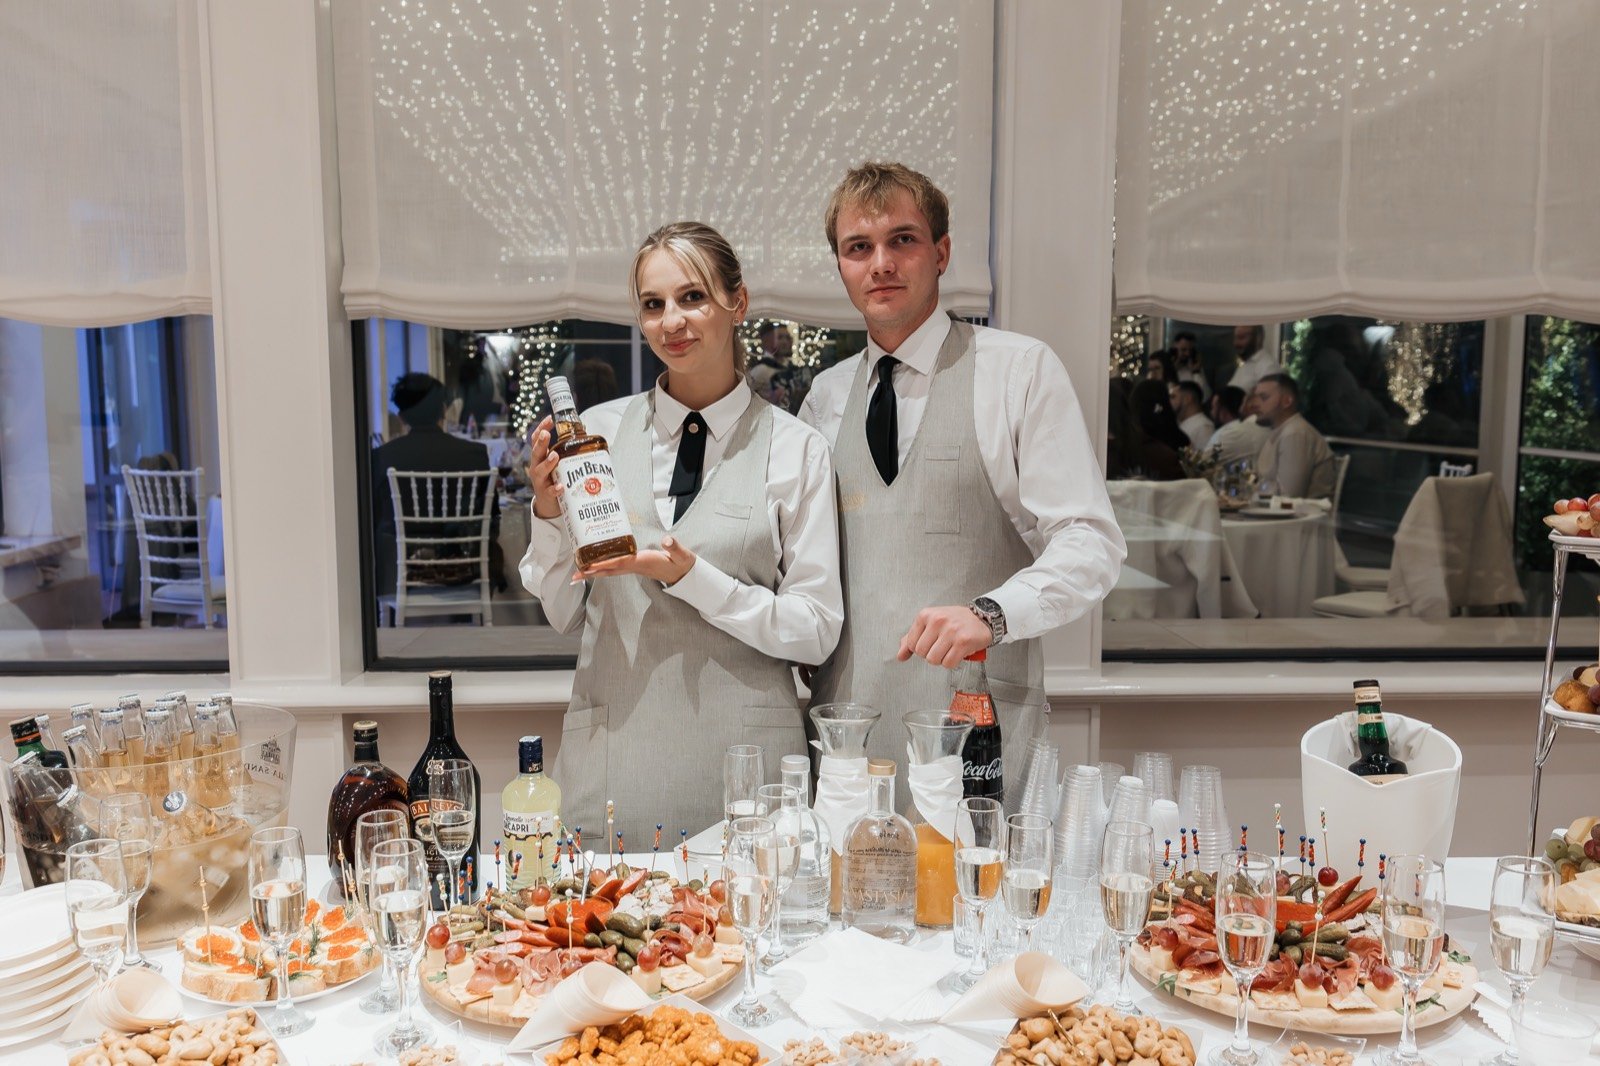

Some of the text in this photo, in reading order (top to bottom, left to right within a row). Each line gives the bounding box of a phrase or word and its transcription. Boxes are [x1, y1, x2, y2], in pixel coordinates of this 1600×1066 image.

[566, 461, 615, 489] JIM BEAM
[578, 501, 621, 521] BOURBON
[411, 800, 461, 815] BAILEYS
